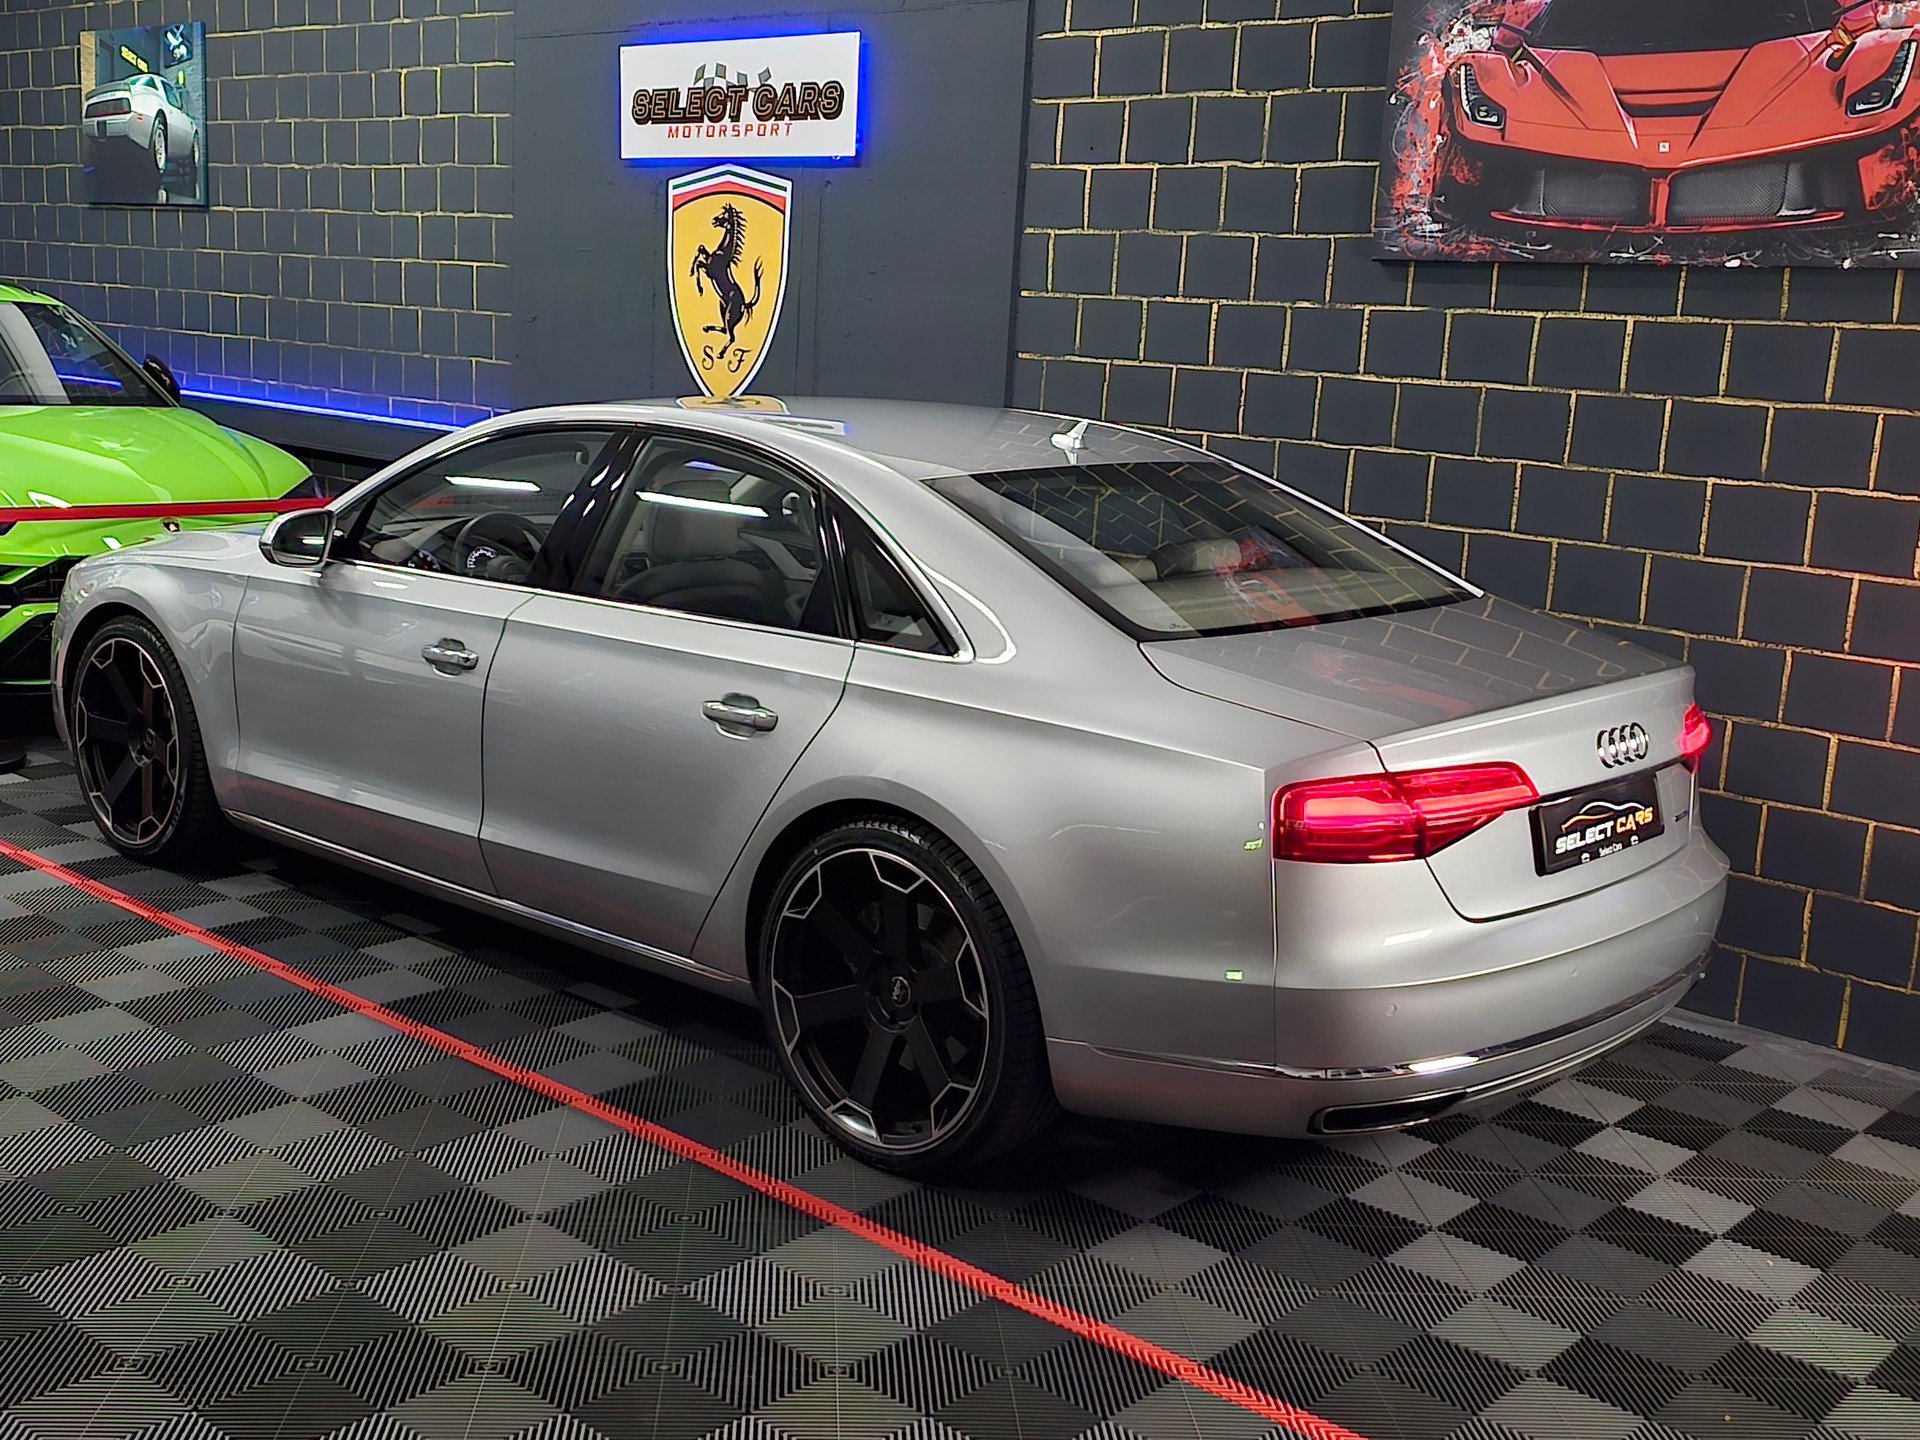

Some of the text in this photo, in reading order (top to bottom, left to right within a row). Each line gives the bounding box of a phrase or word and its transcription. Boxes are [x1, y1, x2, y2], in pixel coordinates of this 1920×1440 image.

[632, 81, 844, 124] SELECT CARS
[667, 123, 793, 139] MOTORSPORT
[702, 345, 752, 373] S F
[1555, 820, 1615, 855] SELECT
[1616, 807, 1653, 834] CARS
